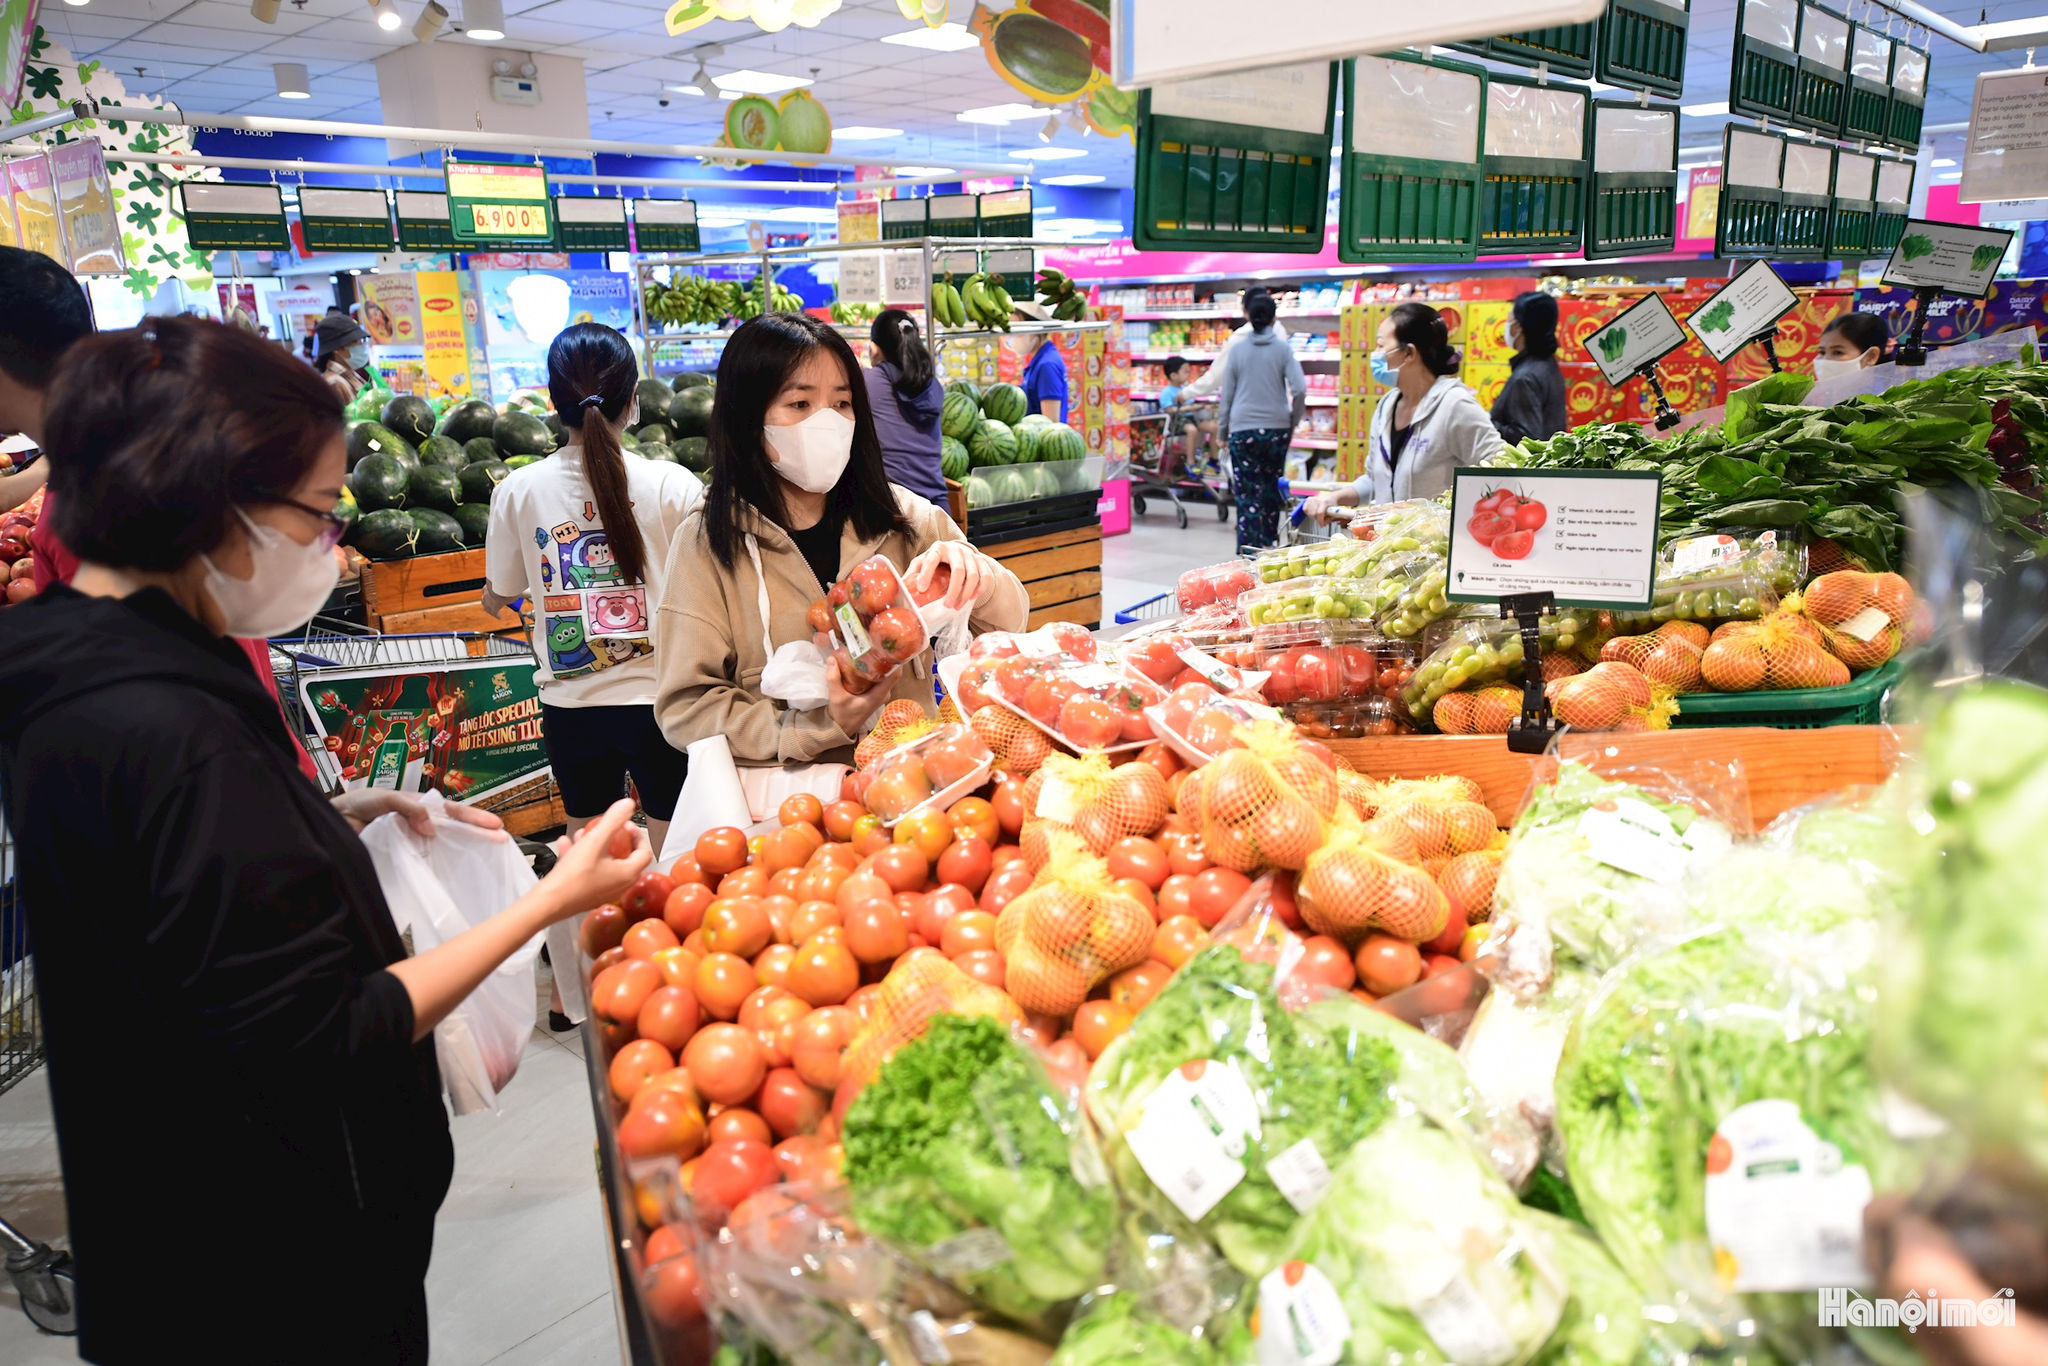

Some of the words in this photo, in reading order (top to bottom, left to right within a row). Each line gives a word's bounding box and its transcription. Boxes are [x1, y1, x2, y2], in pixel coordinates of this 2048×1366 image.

[448, 165, 478, 174] Khuyến
[480, 166, 494, 174] mãi
[1693, 173, 1720, 184] Khu
[1858, 301, 1889, 312] DAIRY
[556, 525, 576, 538] HI!
[492, 690, 513, 700] SAIGON
[460, 716, 478, 734] TẶNG
[479, 710, 495, 731] LỘC
[496, 696, 542, 725] SPECIAL
[458, 733, 471, 752] MỞ
[472, 729, 487, 749] TẾT
[488, 724, 516, 746] SUNG
[518, 716, 544, 740] TÚC
[516, 742, 539, 752] SPECIAL
